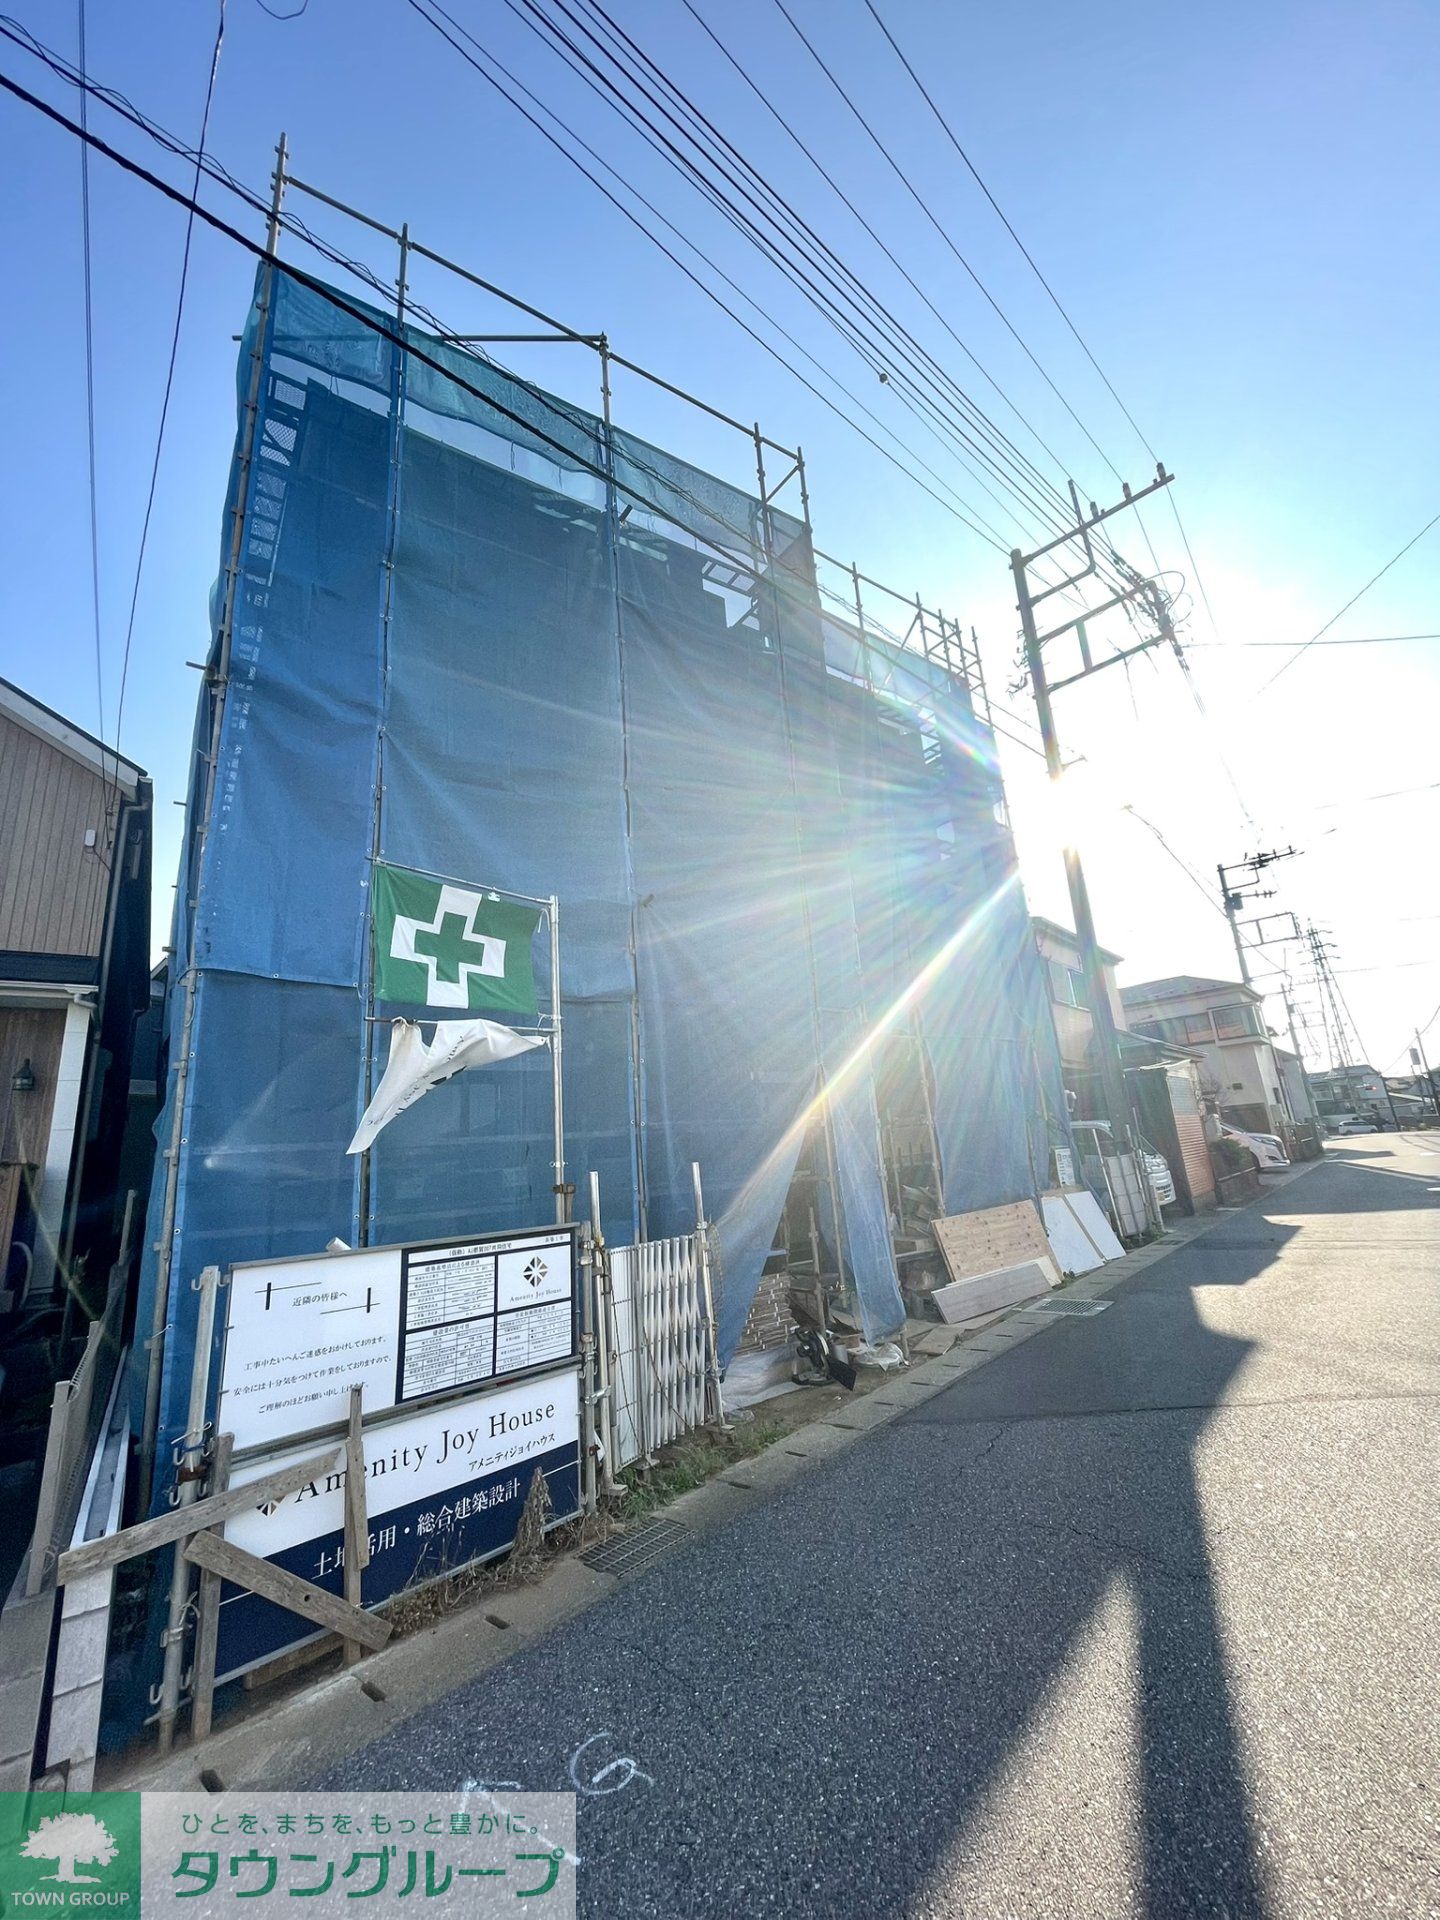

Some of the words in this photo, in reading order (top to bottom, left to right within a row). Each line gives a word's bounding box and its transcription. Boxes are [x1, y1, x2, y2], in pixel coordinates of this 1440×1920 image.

[292, 1291, 348, 1307] 近隣の皆様へ
[436, 1429, 480, 1464] Joy
[488, 1403, 556, 1439] House
[469, 1432, 556, 1472] アメニティジョイハウス
